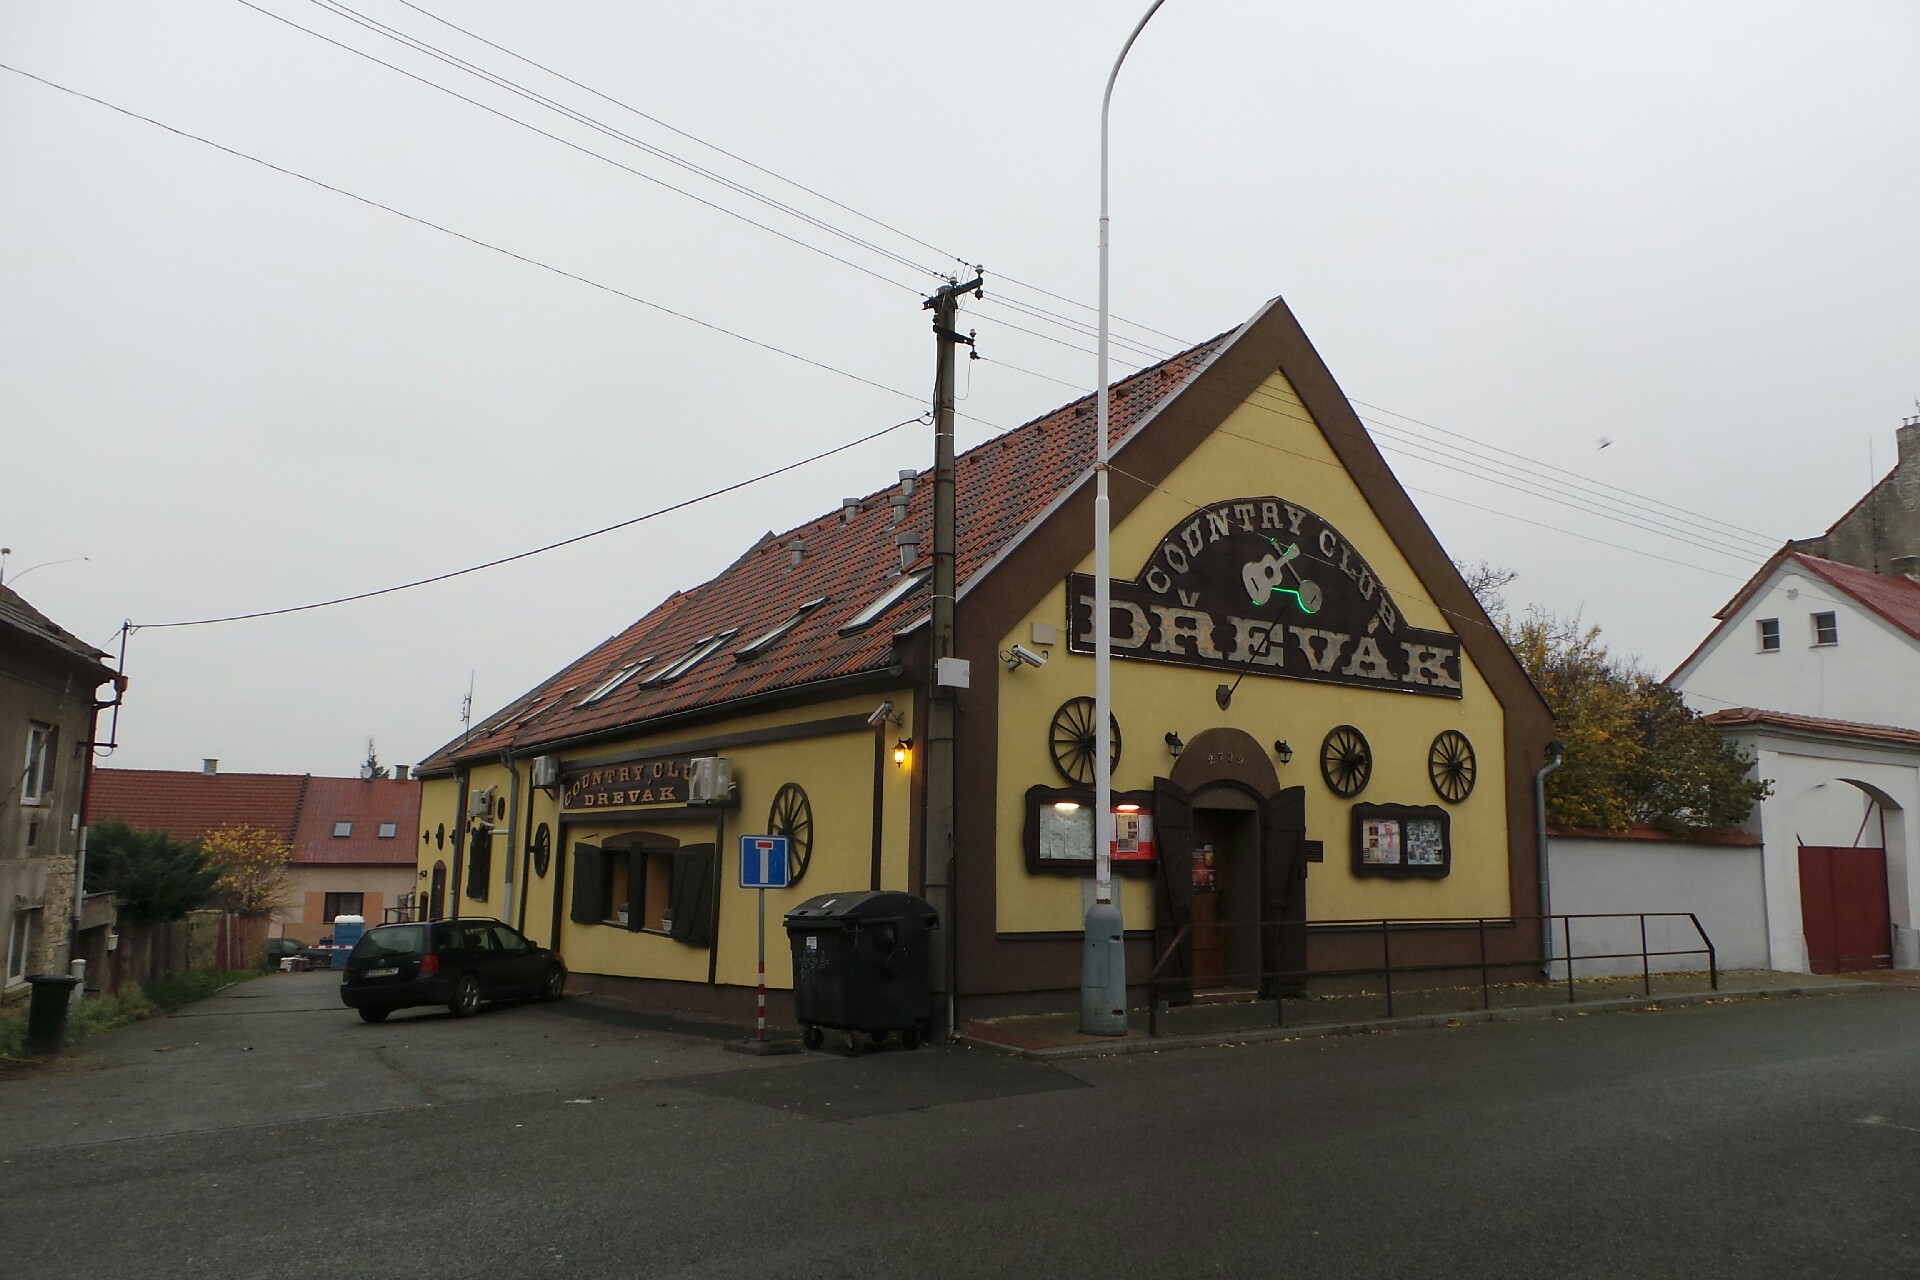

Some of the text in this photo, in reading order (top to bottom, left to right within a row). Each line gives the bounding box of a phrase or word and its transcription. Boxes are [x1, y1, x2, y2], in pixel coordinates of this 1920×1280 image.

[1145, 502, 1396, 634] COUNTRY CLUB
[1079, 589, 1461, 690] DŘEVÁK
[564, 761, 691, 806] COUNTRY CLU
[584, 780, 676, 806] DŘEVÁK
